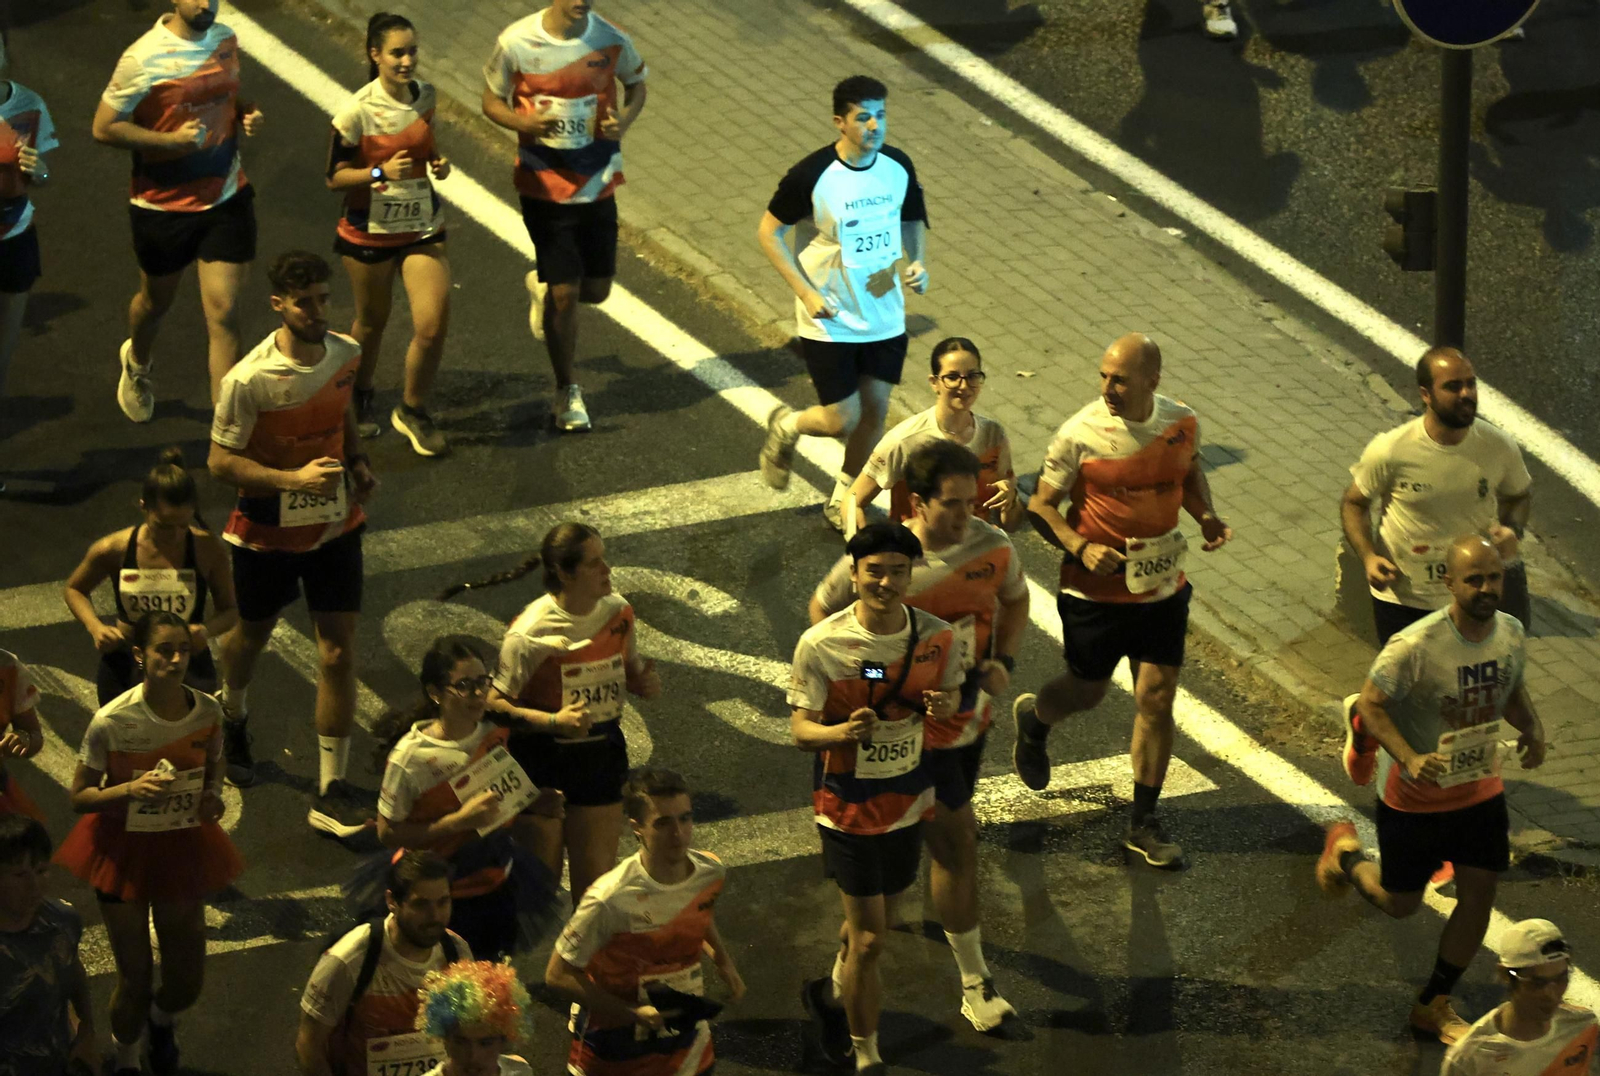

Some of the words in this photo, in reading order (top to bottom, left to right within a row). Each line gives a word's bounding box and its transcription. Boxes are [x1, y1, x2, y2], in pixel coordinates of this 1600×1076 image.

[556, 119, 586, 135] 936
[383, 202, 421, 219] 7718
[845, 194, 893, 210] HITACHI
[855, 231, 890, 253] 2370
[1425, 563, 1447, 580] 19
[129, 595, 187, 614] 23913
[570, 682, 620, 706] 23479
[865, 738, 916, 763] 20561
[489, 769, 522, 802] 345
